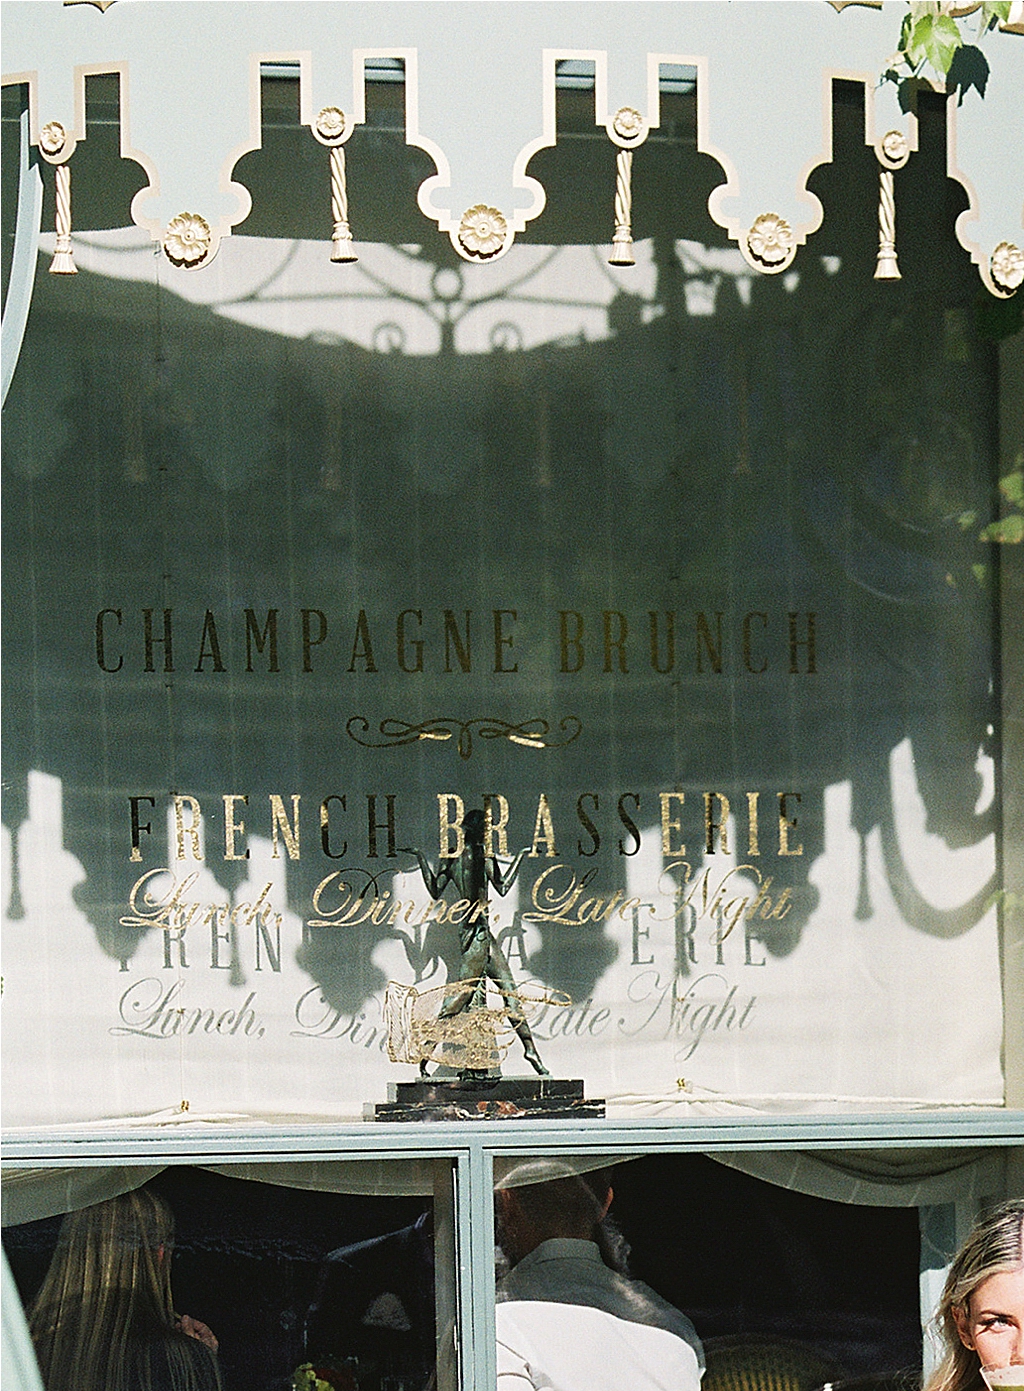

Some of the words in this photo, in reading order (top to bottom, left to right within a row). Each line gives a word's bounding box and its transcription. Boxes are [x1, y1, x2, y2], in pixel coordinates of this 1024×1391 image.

[94, 608, 519, 674] CHAMPAGNE
[557, 609, 818, 675] BRUNCH
[128, 793, 397, 862] FRENCH
[437, 791, 804, 861] BRASSERIE
[119, 867, 283, 930] Lunch,
[307, 867, 500, 927] Dinner,
[521, 864, 642, 926] Late
[649, 860, 793, 945] Night
